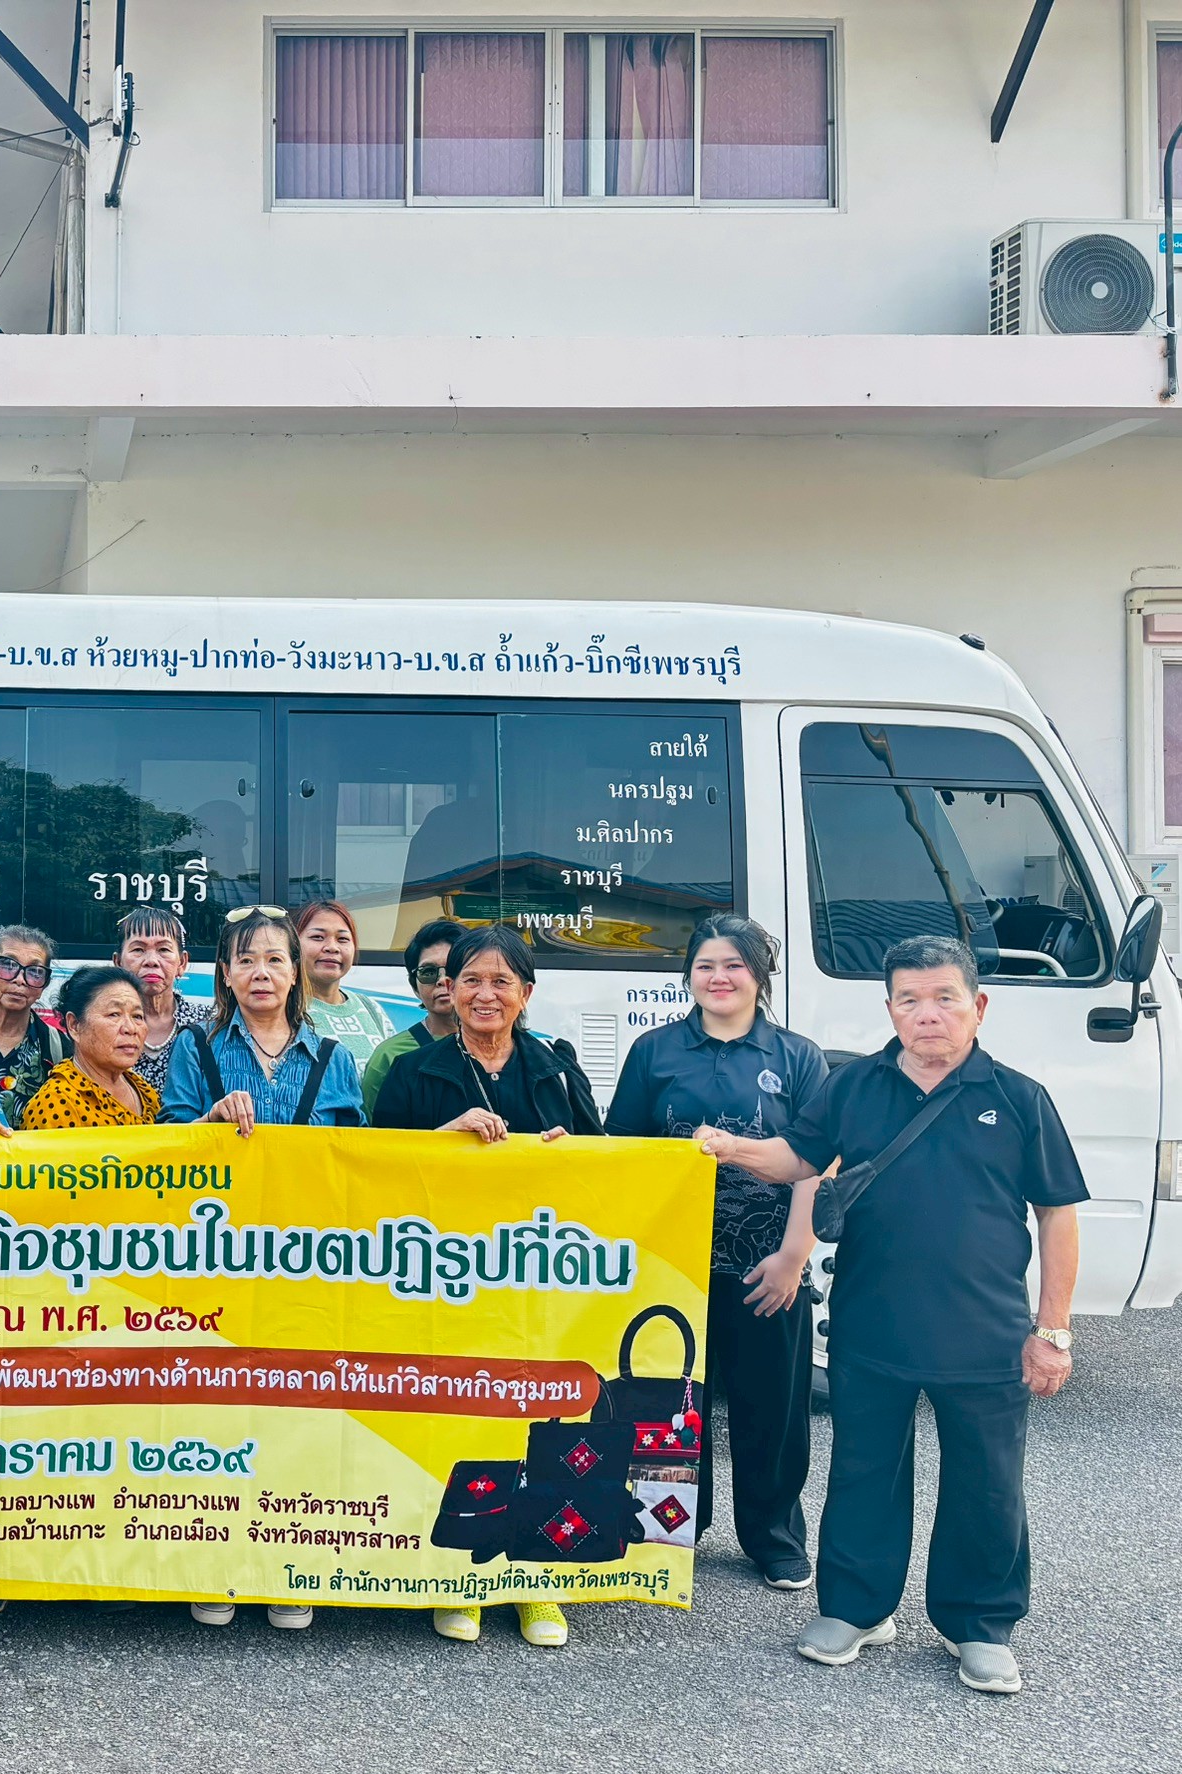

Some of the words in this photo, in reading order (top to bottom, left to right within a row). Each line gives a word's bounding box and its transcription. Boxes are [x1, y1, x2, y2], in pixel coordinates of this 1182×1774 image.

[495, 633, 741, 684] ถ้ำแก้ว-บิ๊กซีเพชรบุรี
[649, 733, 709, 757] สายใต้
[608, 776, 693, 805] นครปฐม
[576, 819, 674, 844] ม.ศิลปากร
[87, 857, 209, 915] ราชบุรี
[560, 862, 623, 893] ราชบุรี
[517, 904, 594, 936] เพชรบุรี
[40, 1304, 108, 1332] พ.ศ.
[123, 1305, 224, 1332] ๒๕๖๙
[130, 1440, 254, 1474] ๒๕๖๙
[113, 1487, 240, 1512] อำเภอบางแพ
[257, 1490, 390, 1526] จังหวัดราชบุรี
[123, 1515, 230, 1543] อำเภอเมือง
[246, 1520, 421, 1554] จังหวัดสมุทรสาคร
[283, 1563, 321, 1590] โดย
[329, 1563, 670, 1601] สำนักงานการปฏิรูปที่ดินจังหวัดเพชรบุรี
